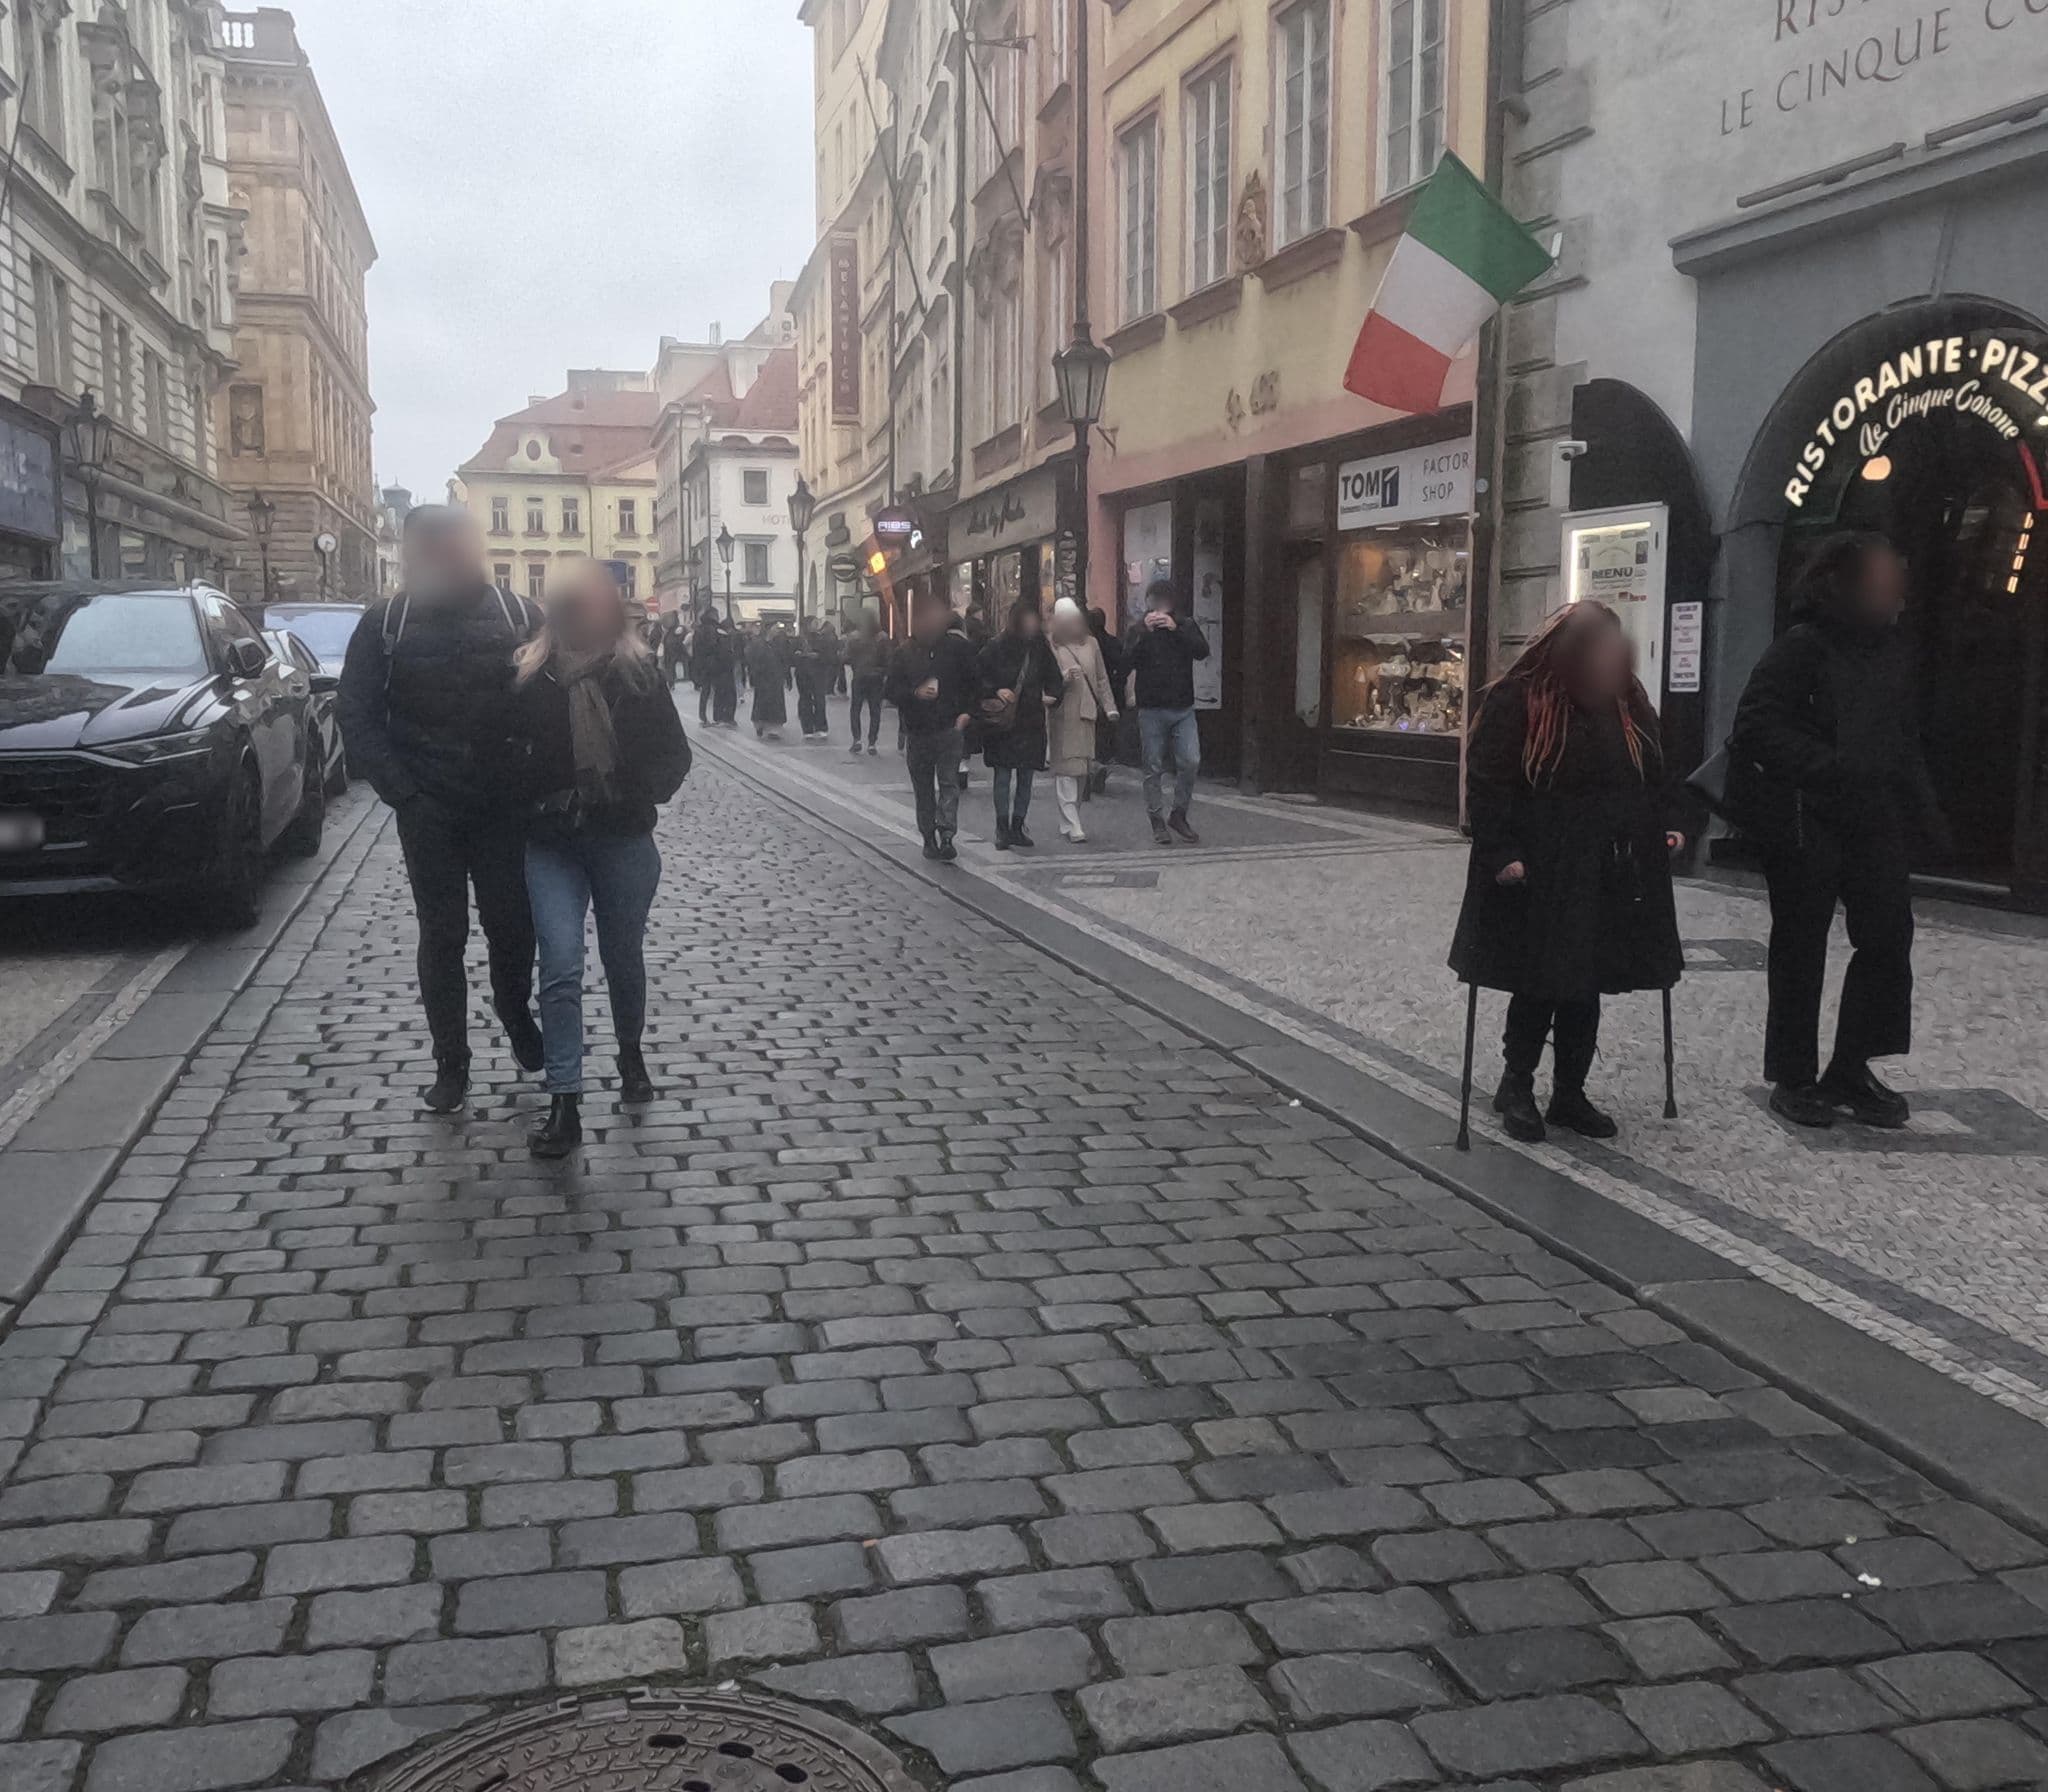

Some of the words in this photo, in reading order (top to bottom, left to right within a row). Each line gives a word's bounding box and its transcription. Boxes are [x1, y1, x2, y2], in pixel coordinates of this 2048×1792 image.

[1720, 88, 1754, 136] LE
[1776, 7, 1951, 112] CINQUE
[1784, 336, 1964, 507] RISTORANTE
[1980, 337, 2048, 412] PIZZ
[1886, 387, 1953, 429] Cinque
[1955, 379, 2020, 440] Corone
[1422, 481, 1454, 502] SHOP
[1591, 566, 1634, 579] MENU
